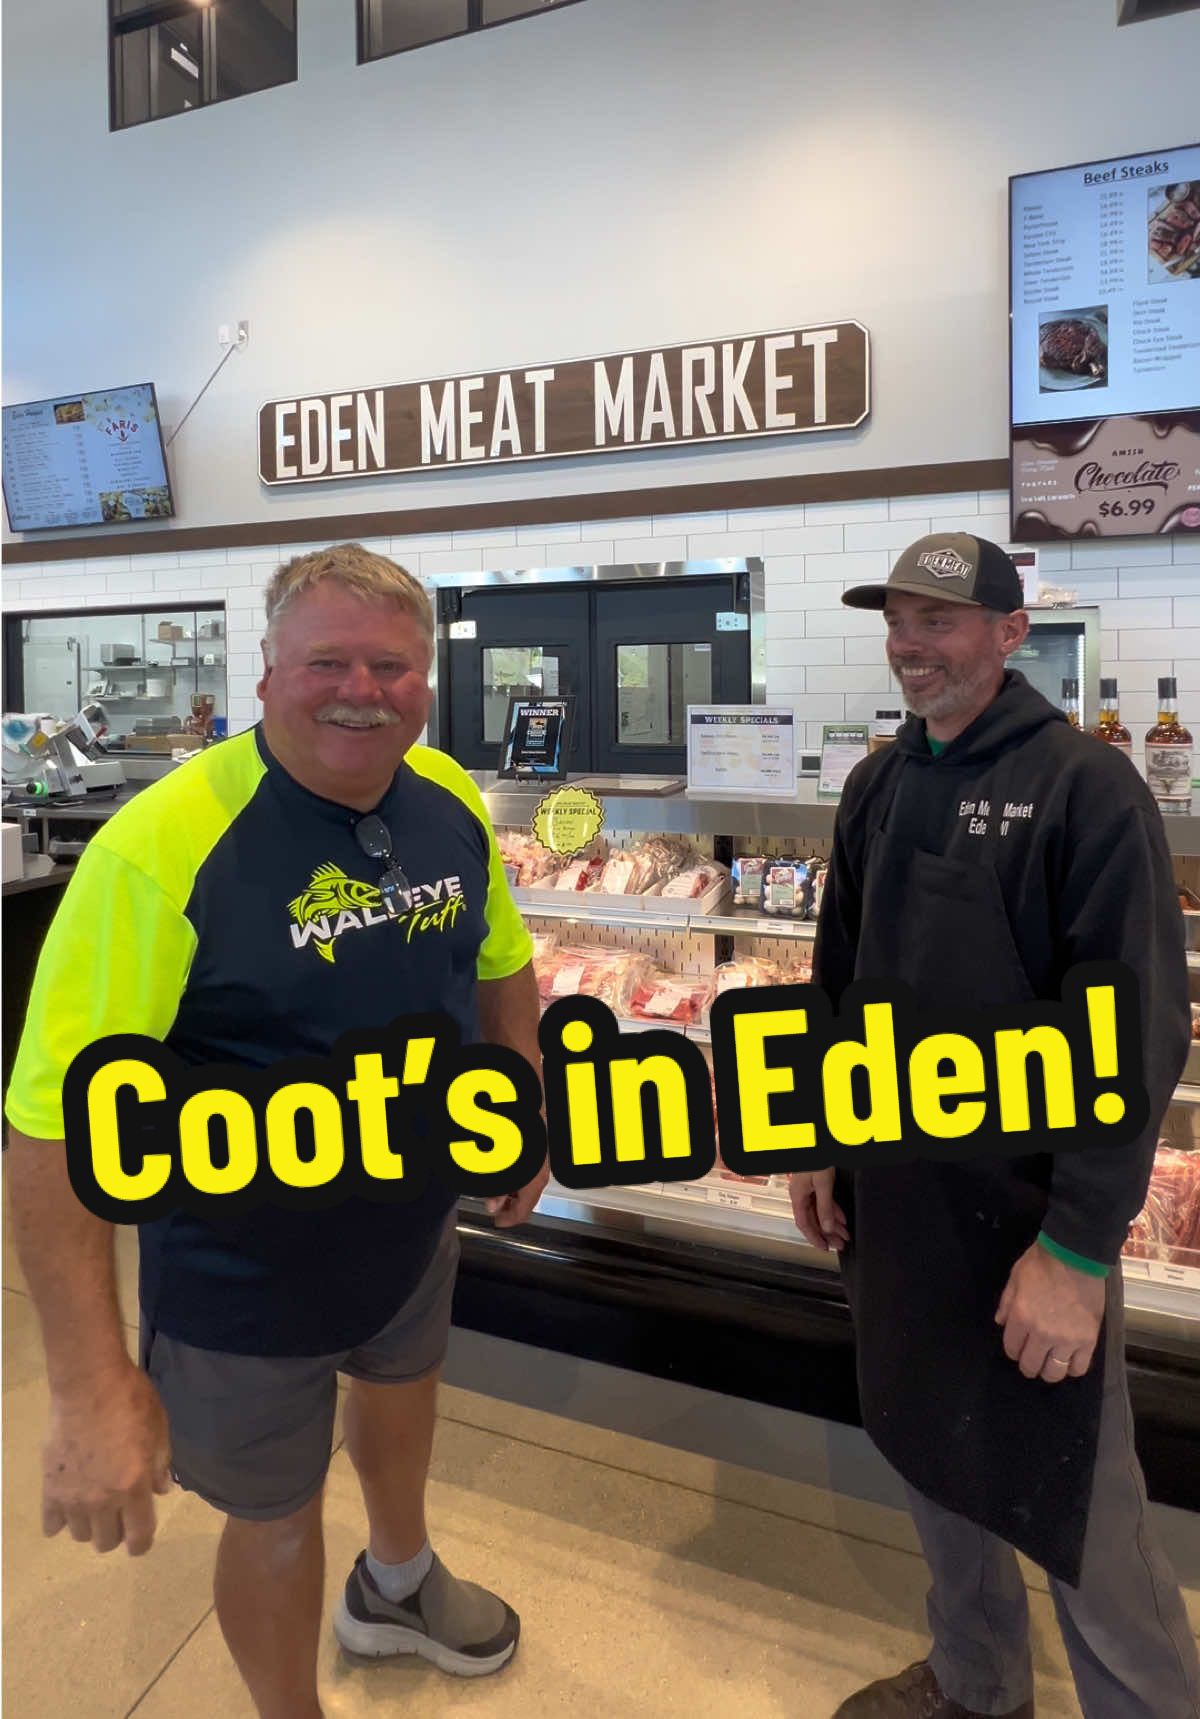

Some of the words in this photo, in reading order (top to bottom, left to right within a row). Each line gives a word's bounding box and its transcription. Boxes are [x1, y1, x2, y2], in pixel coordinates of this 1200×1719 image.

[1083, 167, 1116, 185] Beef
[1120, 160, 1169, 178] Steaks
[275, 389, 385, 479] EDEN
[420, 368, 555, 464] MEAT
[594, 328, 838, 447] MARKET
[1111, 448, 1145, 457] AMISH
[1074, 460, 1181, 494] Chocolate
[1098, 498, 1156, 518] $6.99
[520, 708, 559, 717] WINNER
[704, 715, 737, 724] WEEKLY
[740, 715, 779, 725] SPECIALS
[569, 807, 597, 816] SPECIAL
[289, 875, 464, 949] WALLEYE
